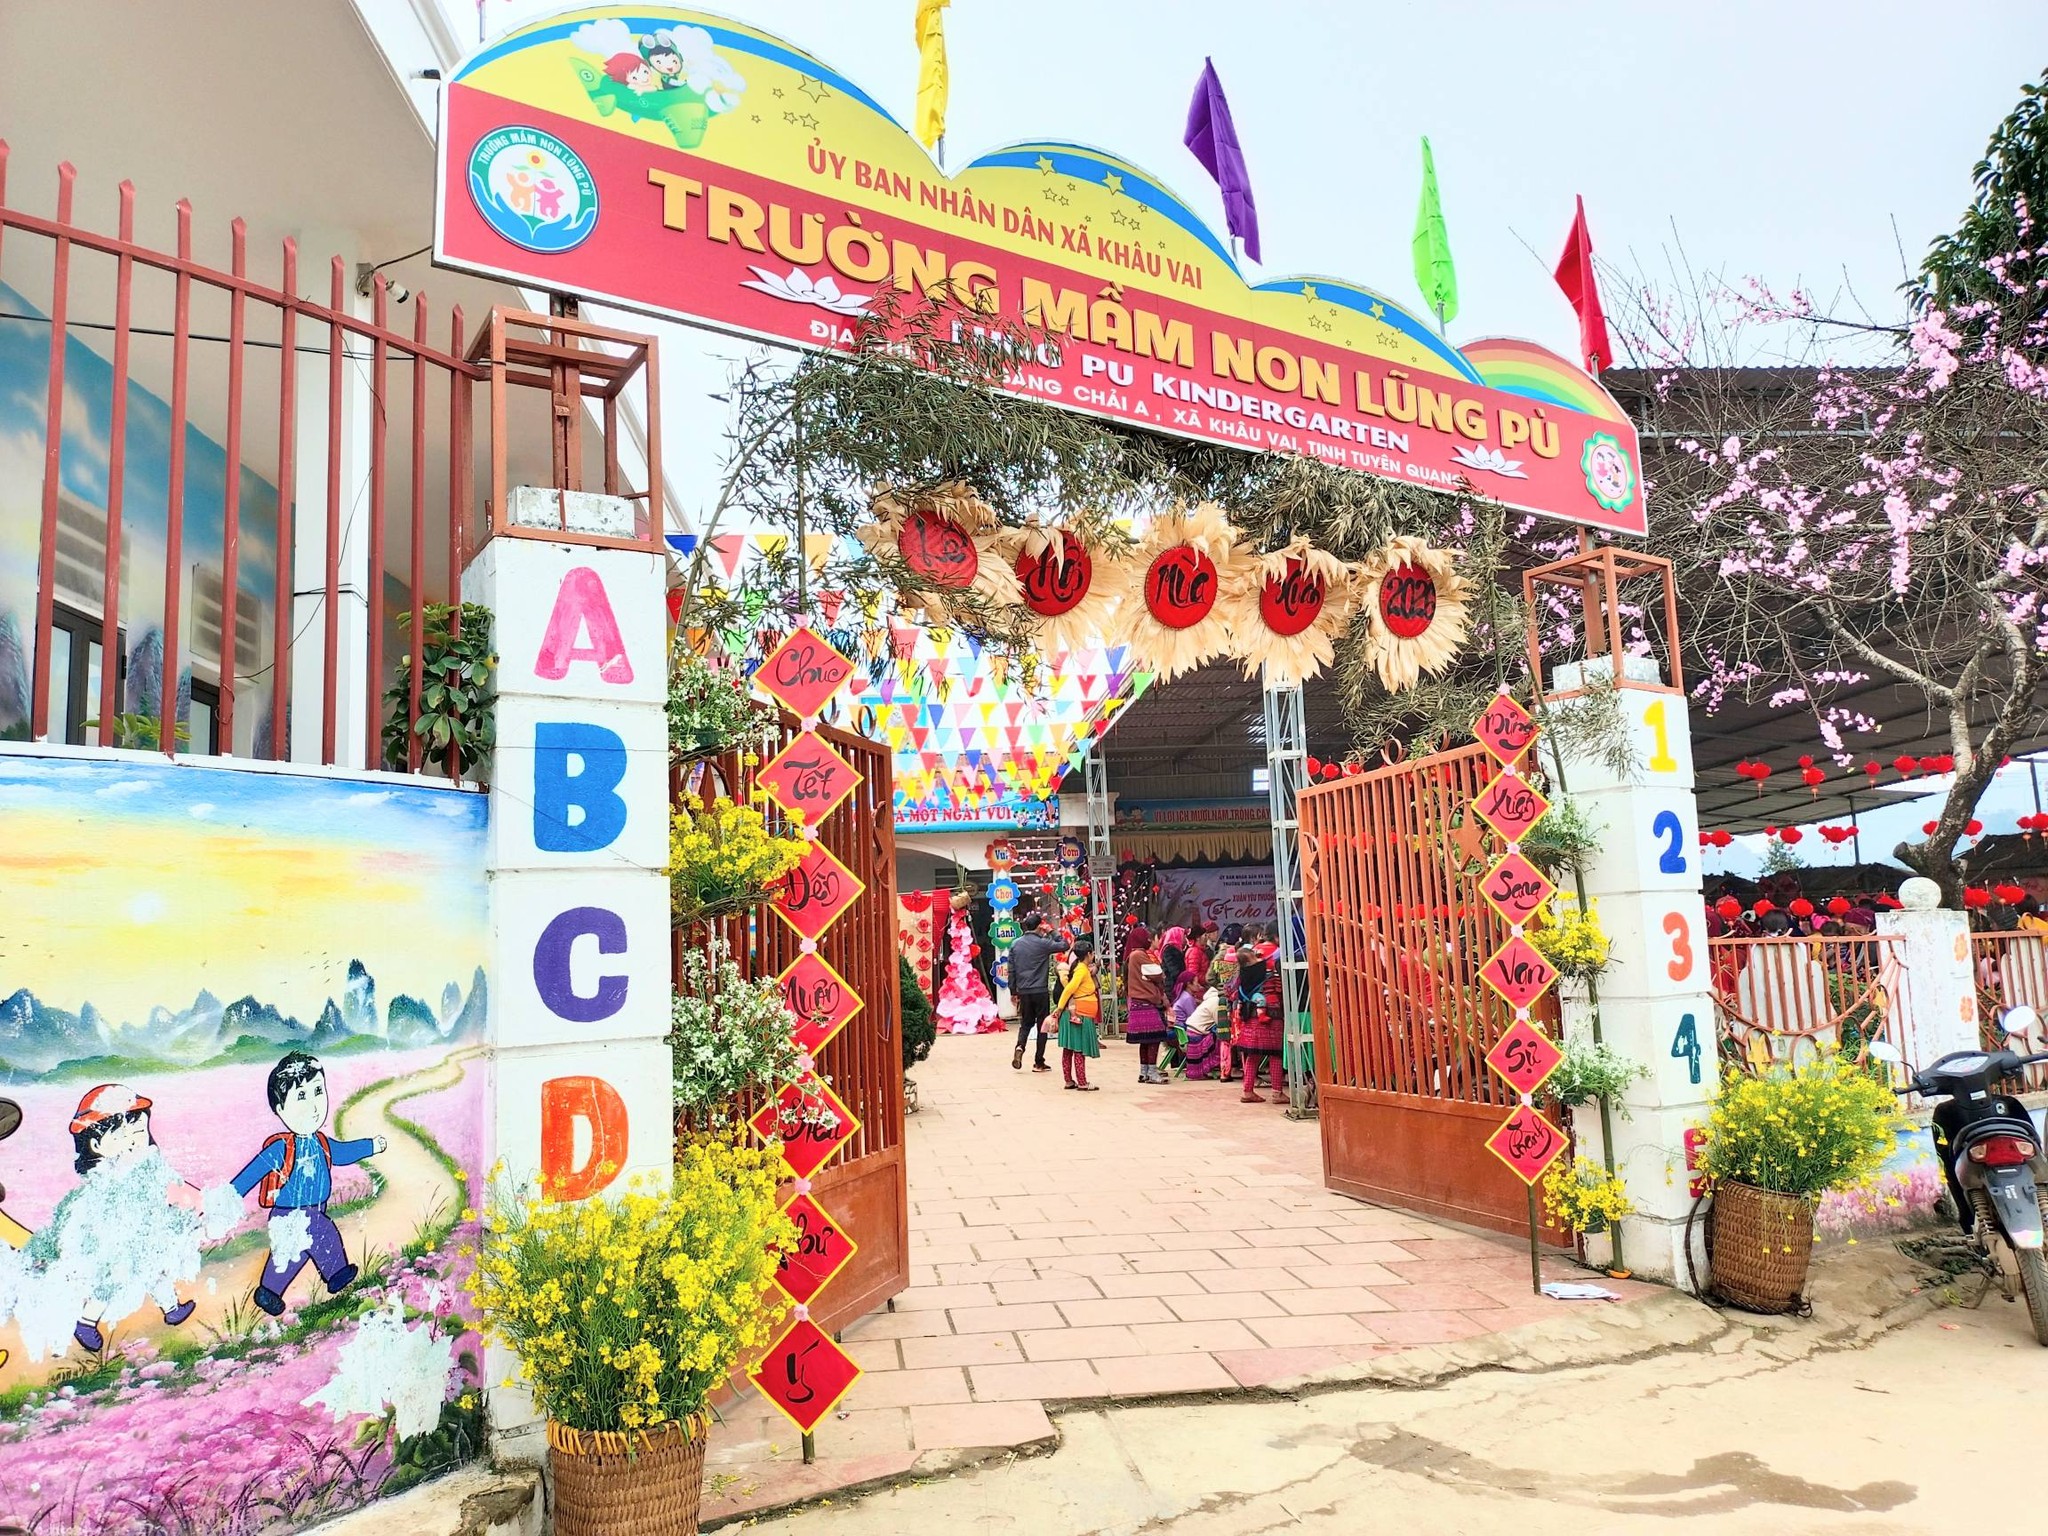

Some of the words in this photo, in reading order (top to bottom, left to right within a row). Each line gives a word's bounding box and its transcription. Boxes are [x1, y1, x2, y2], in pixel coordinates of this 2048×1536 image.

[540, 137, 564, 157] NON
[807, 137, 847, 180] ỦY
[855, 160, 911, 202] BAN
[919, 181, 995, 228] NHÂN
[1003, 206, 1055, 246] DÂN
[1061, 225, 1092, 257] XÃ
[1098, 236, 1162, 278] KHÂU
[1166, 257, 1202, 290] VAI
[647, 168, 1000, 316] TRƯỜNG
[1021, 277, 1196, 367] MẦM
[1211, 330, 1342, 407] NON
[1356, 369, 1488, 442] LŨNG
[1500, 401, 1561, 460] PÙ
[809, 319, 856, 347] ĐỊA
[1073, 385, 1128, 411] CHẢI
[1134, 400, 1150, 416] A
[1173, 408, 1202, 428] XÃ
[1209, 417, 1262, 442] KHÂU
[1081, 352, 1135, 387] PU
[1152, 372, 1409, 454] KINDERGARTEN
[533, 566, 635, 685] A
[775, 645, 848, 687] Chúc
[1643, 700, 1678, 773] 1
[534, 722, 627, 852] B
[783, 757, 837, 801] Tết
[1487, 784, 1536, 823] Xuân
[1652, 809, 1687, 874] 2
[782, 857, 840, 912] Đến
[1492, 870, 1542, 911] Sang
[533, 906, 629, 1023] C
[1496, 948, 1551, 993] Vạn
[1663, 911, 1694, 982] 3
[1505, 1038, 1543, 1074] Sự
[1670, 1013, 1702, 1084] 4
[541, 1076, 629, 1202] D
